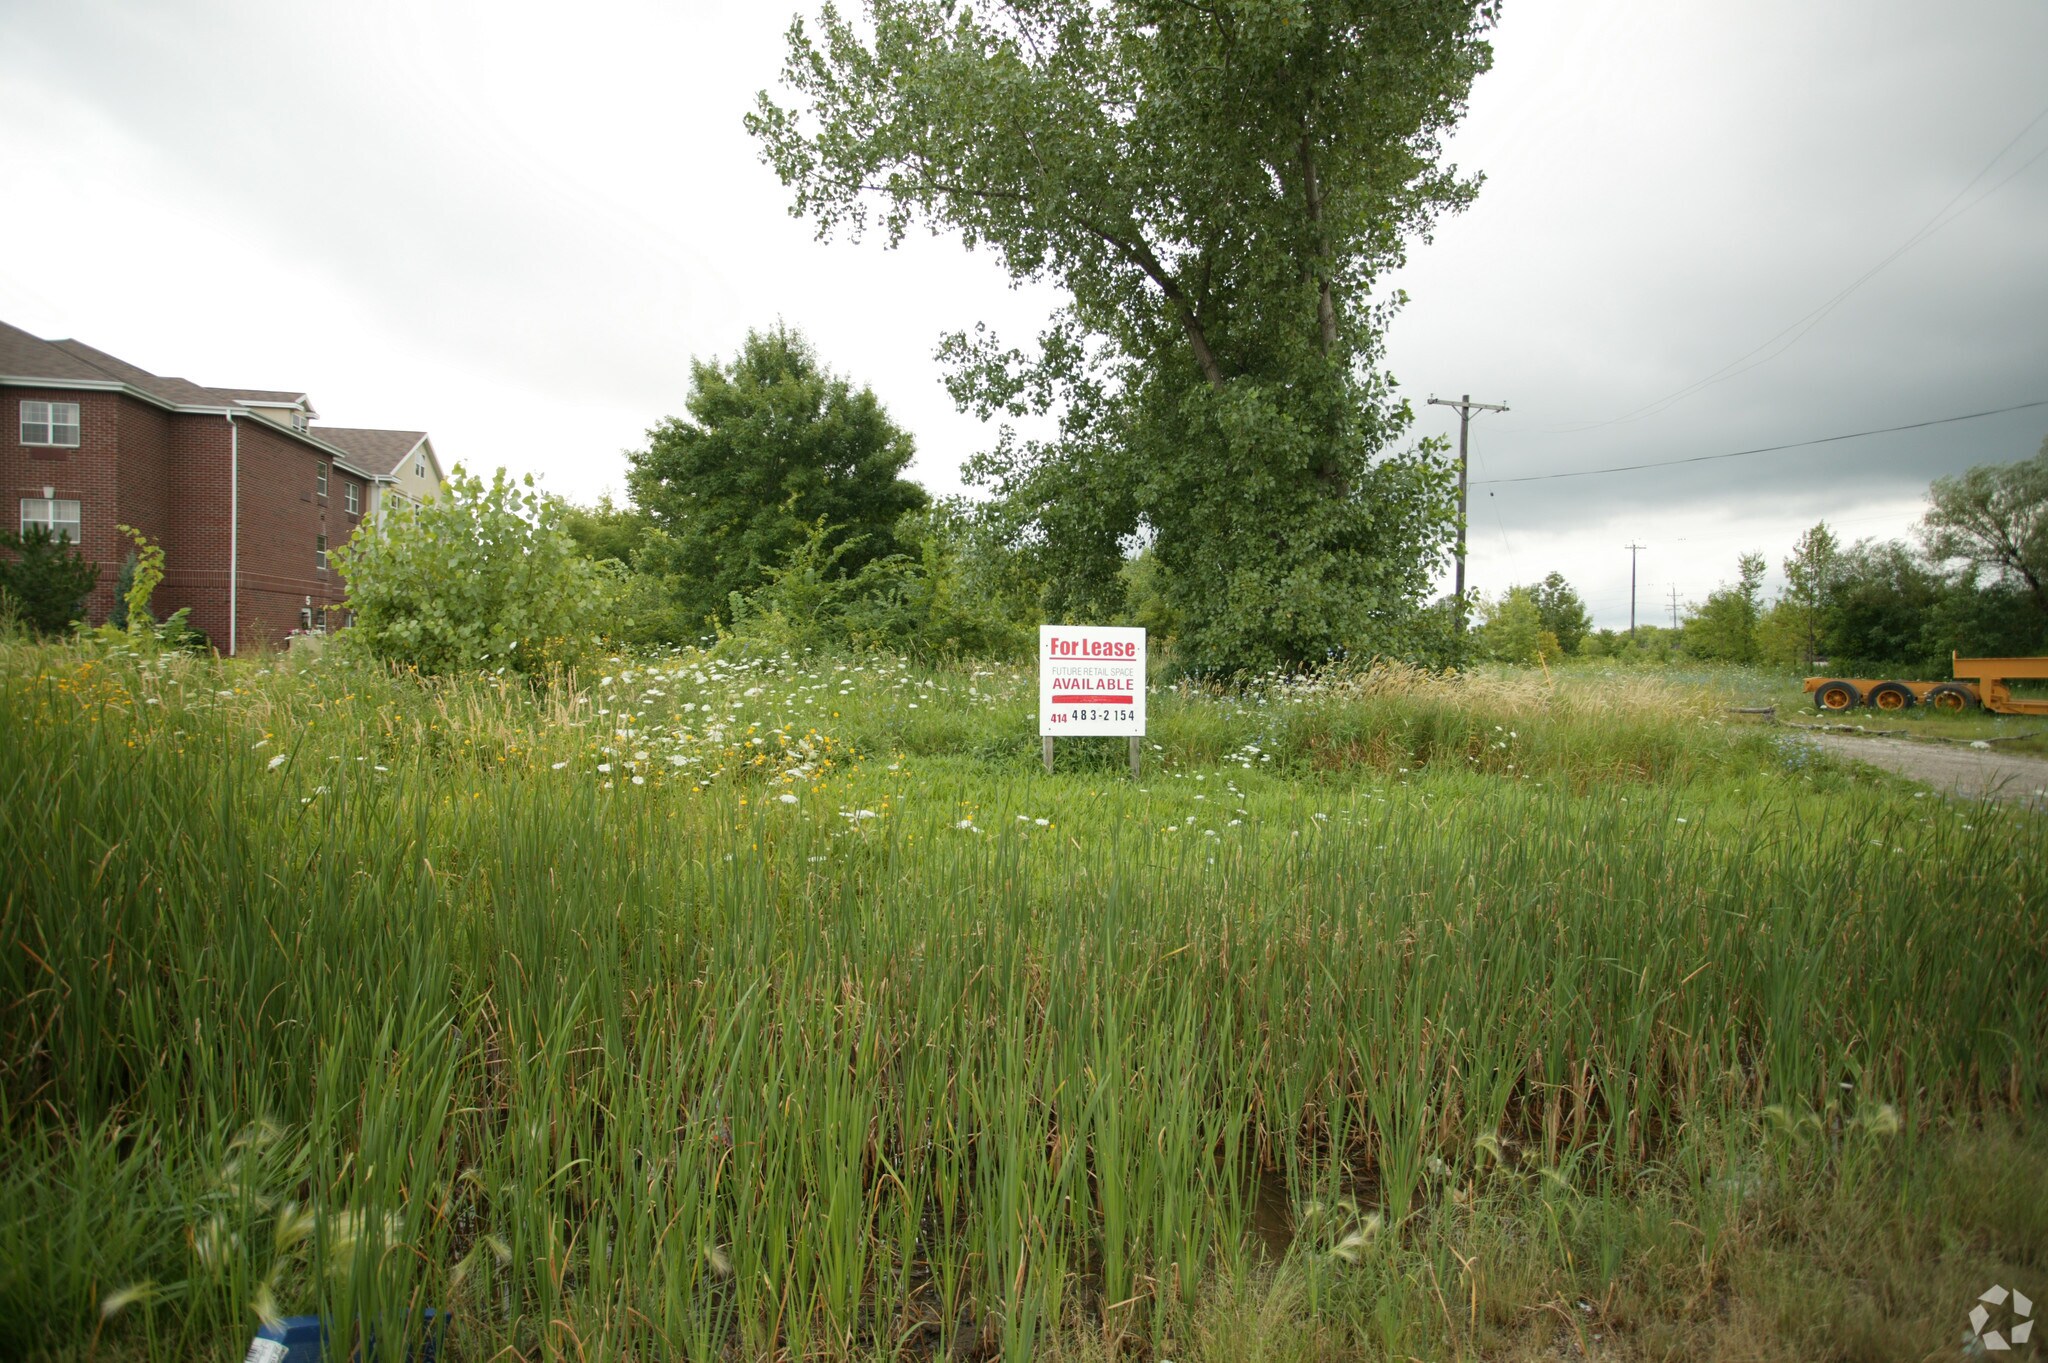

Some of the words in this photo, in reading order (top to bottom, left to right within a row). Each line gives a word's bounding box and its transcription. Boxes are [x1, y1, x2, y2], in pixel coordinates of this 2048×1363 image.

[1050, 637, 1079, 656] For
[1082, 638, 1136, 657] Lease
[1052, 666, 1082, 676] FUTURE
[1083, 667, 1109, 676] RETAIL
[1110, 667, 1134, 677] SPACE
[1052, 678, 1134, 691] AVAILABLE
[1050, 713, 1068, 723] 414
